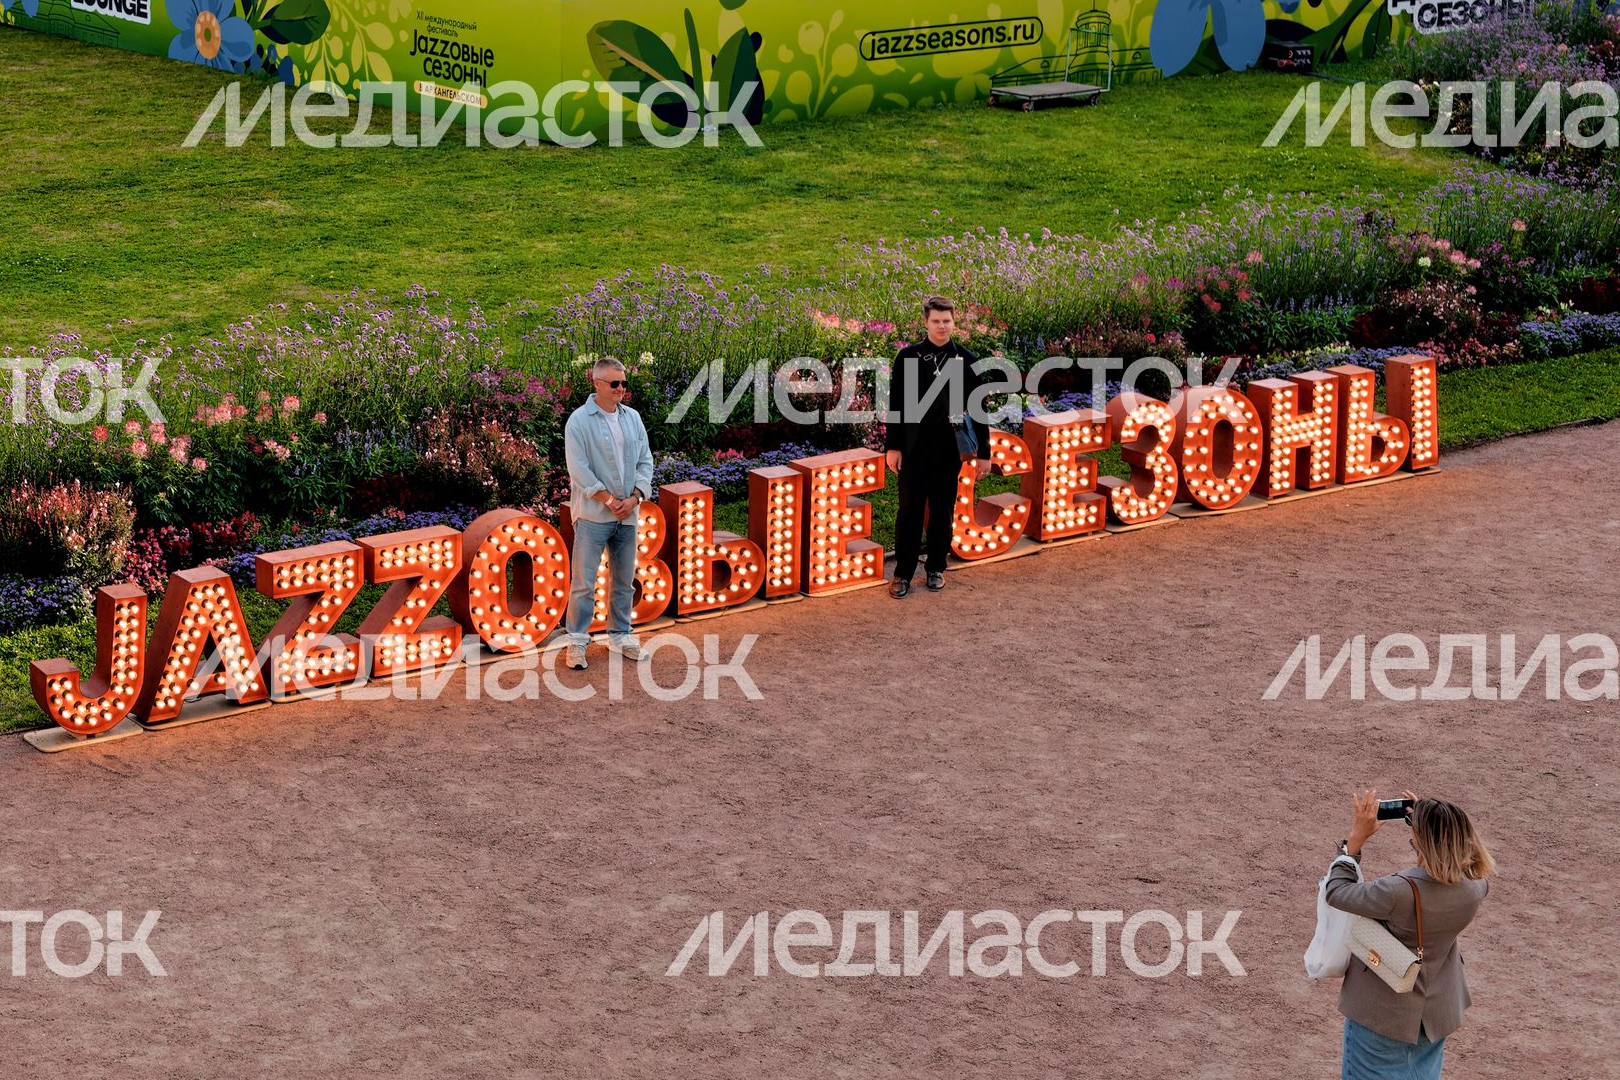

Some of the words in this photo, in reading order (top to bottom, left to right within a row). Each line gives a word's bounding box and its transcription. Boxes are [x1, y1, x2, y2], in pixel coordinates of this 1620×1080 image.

[409, 29, 495, 68] Jazzовые
[870, 23, 1035, 61] jazzseasons.ru
[423, 57, 487, 89] сезоны
[948, 353, 1438, 562] СЕЗОНЫ
